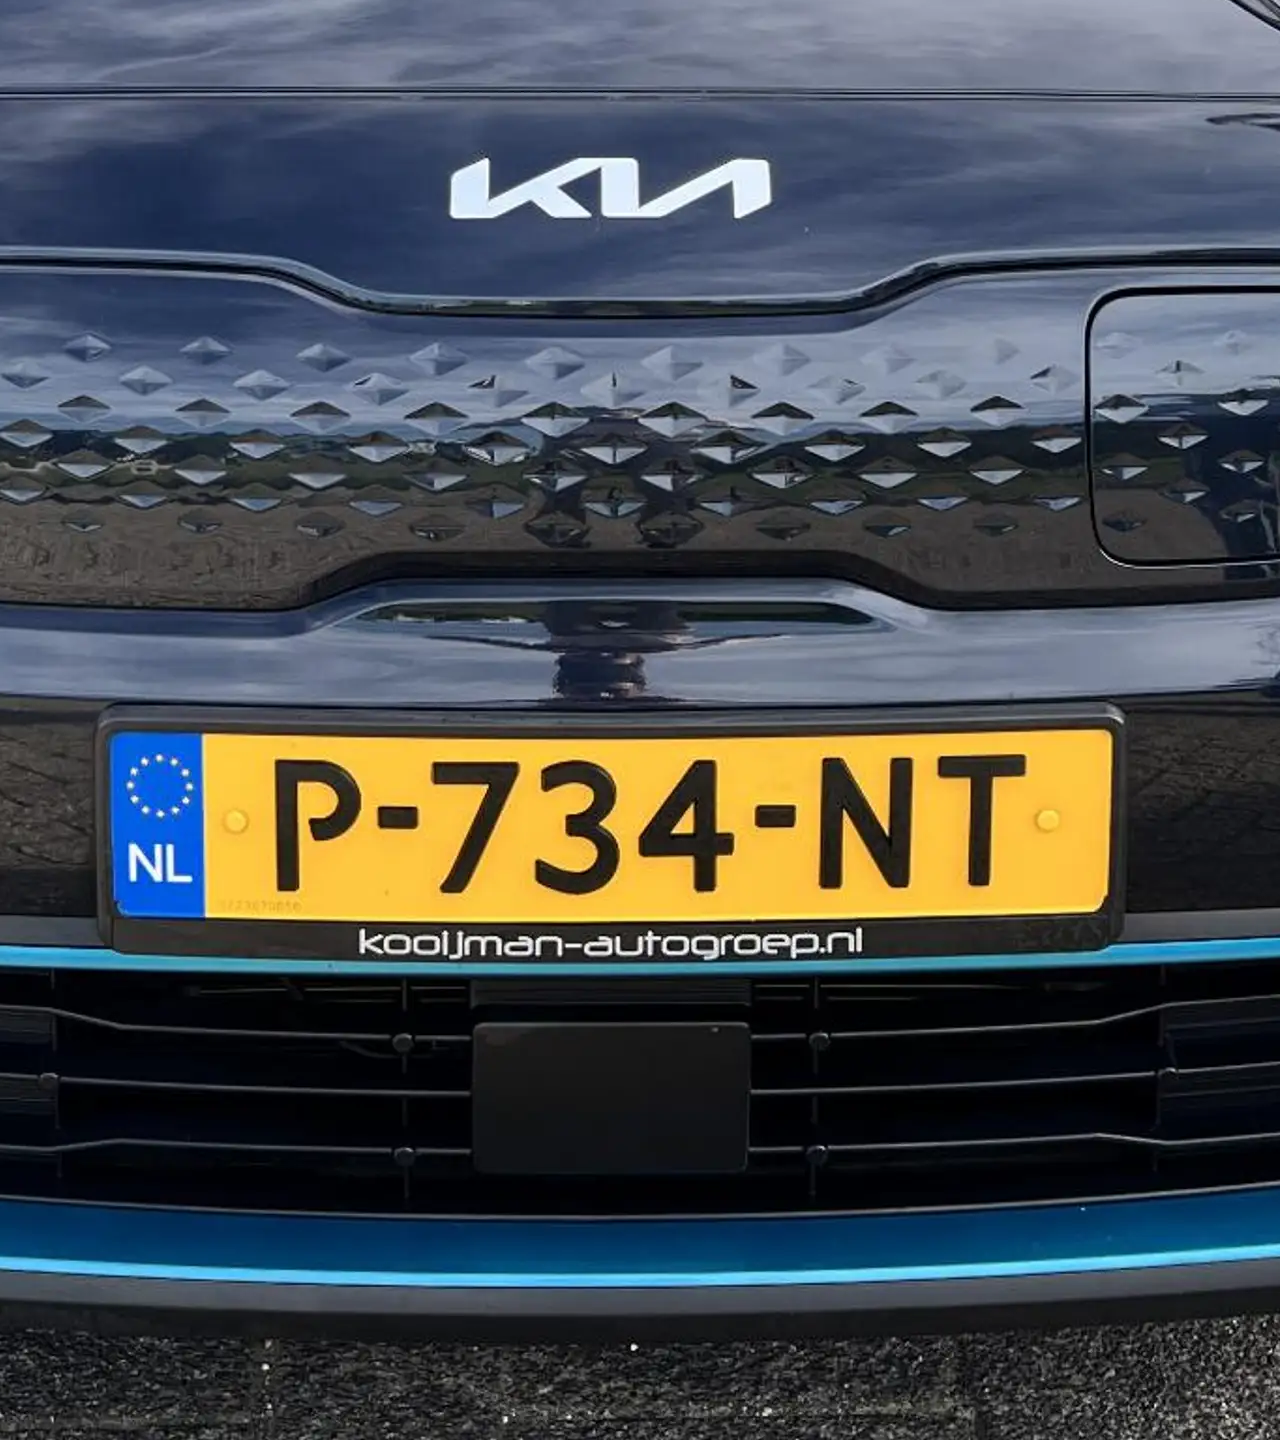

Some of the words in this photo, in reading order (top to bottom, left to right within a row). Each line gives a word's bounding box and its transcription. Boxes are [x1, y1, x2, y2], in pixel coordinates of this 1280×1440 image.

[449, 157, 772, 220] KIA
[274, 753, 1027, 896] P-734-NT
[128, 842, 193, 884] NL
[359, 927, 863, 960] kooijman-autogroep.nl
